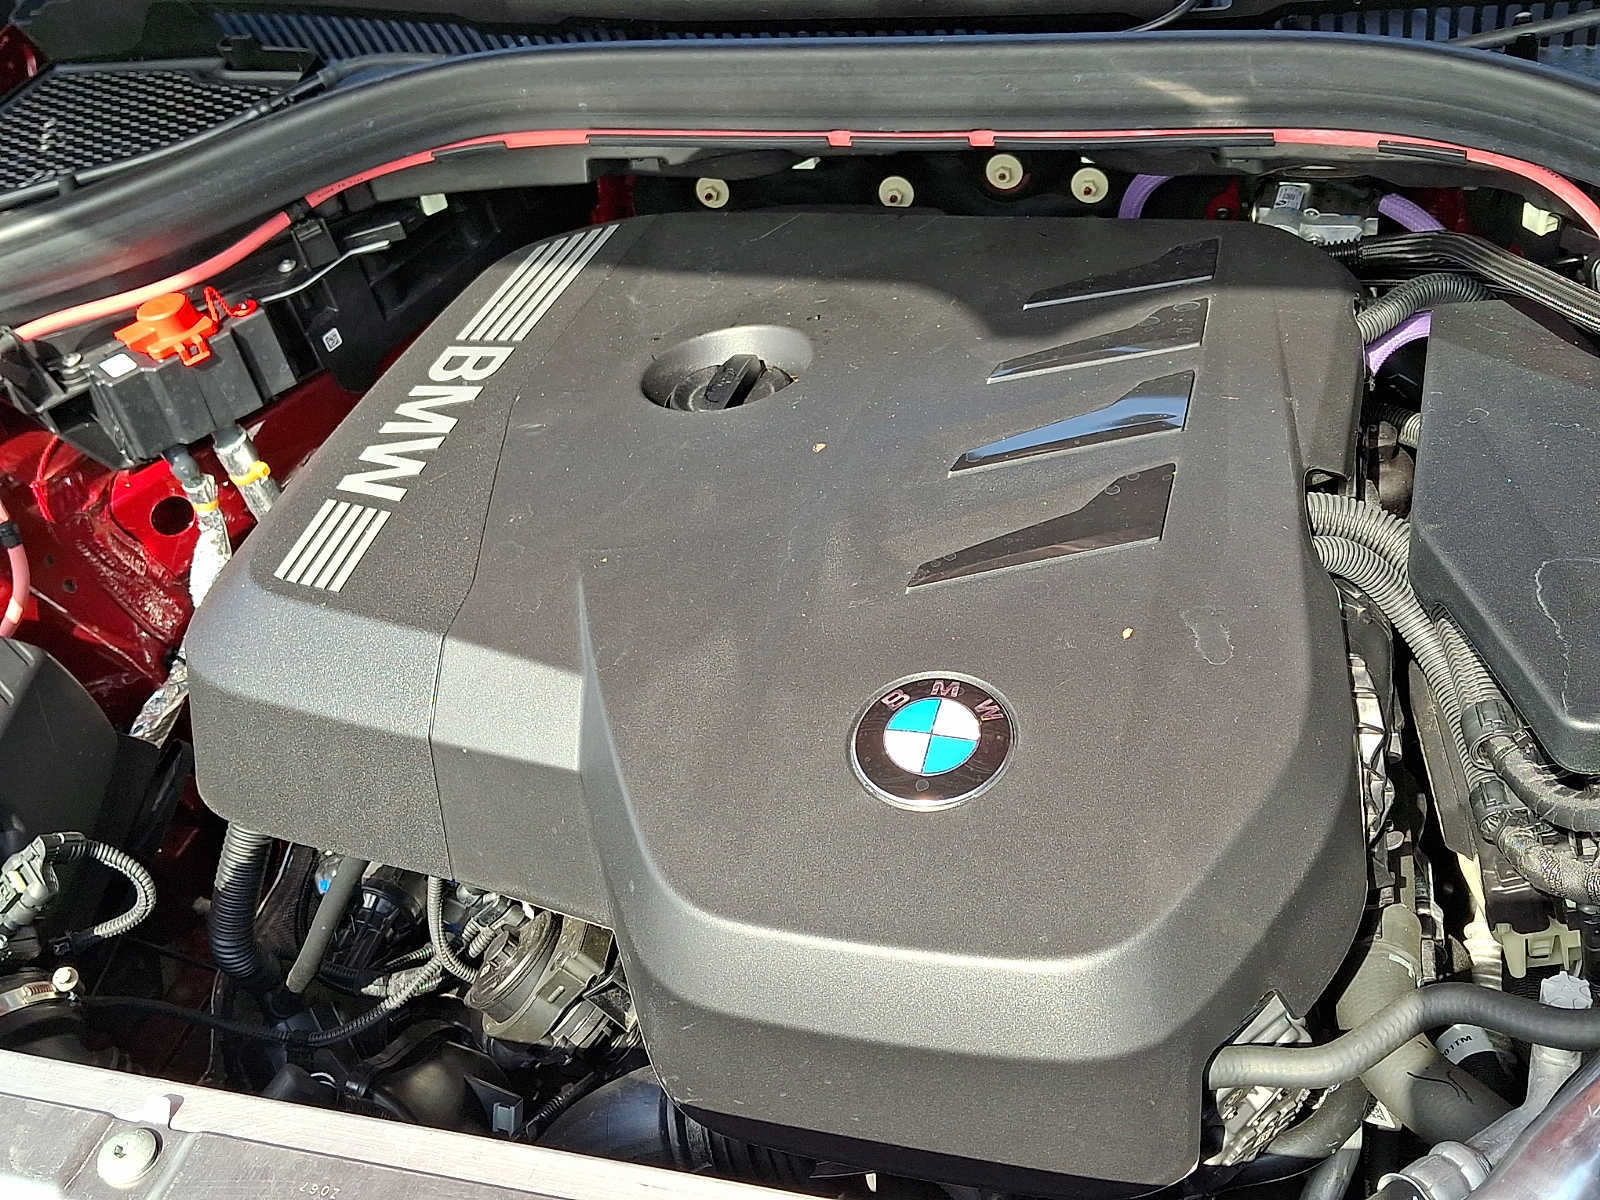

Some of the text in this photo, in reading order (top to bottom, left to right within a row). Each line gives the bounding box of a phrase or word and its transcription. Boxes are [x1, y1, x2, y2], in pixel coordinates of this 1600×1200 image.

[336, 346, 515, 502] BMW
[881, 680, 1004, 722] BMW
[1441, 1034, 1473, 1056] 01TM
